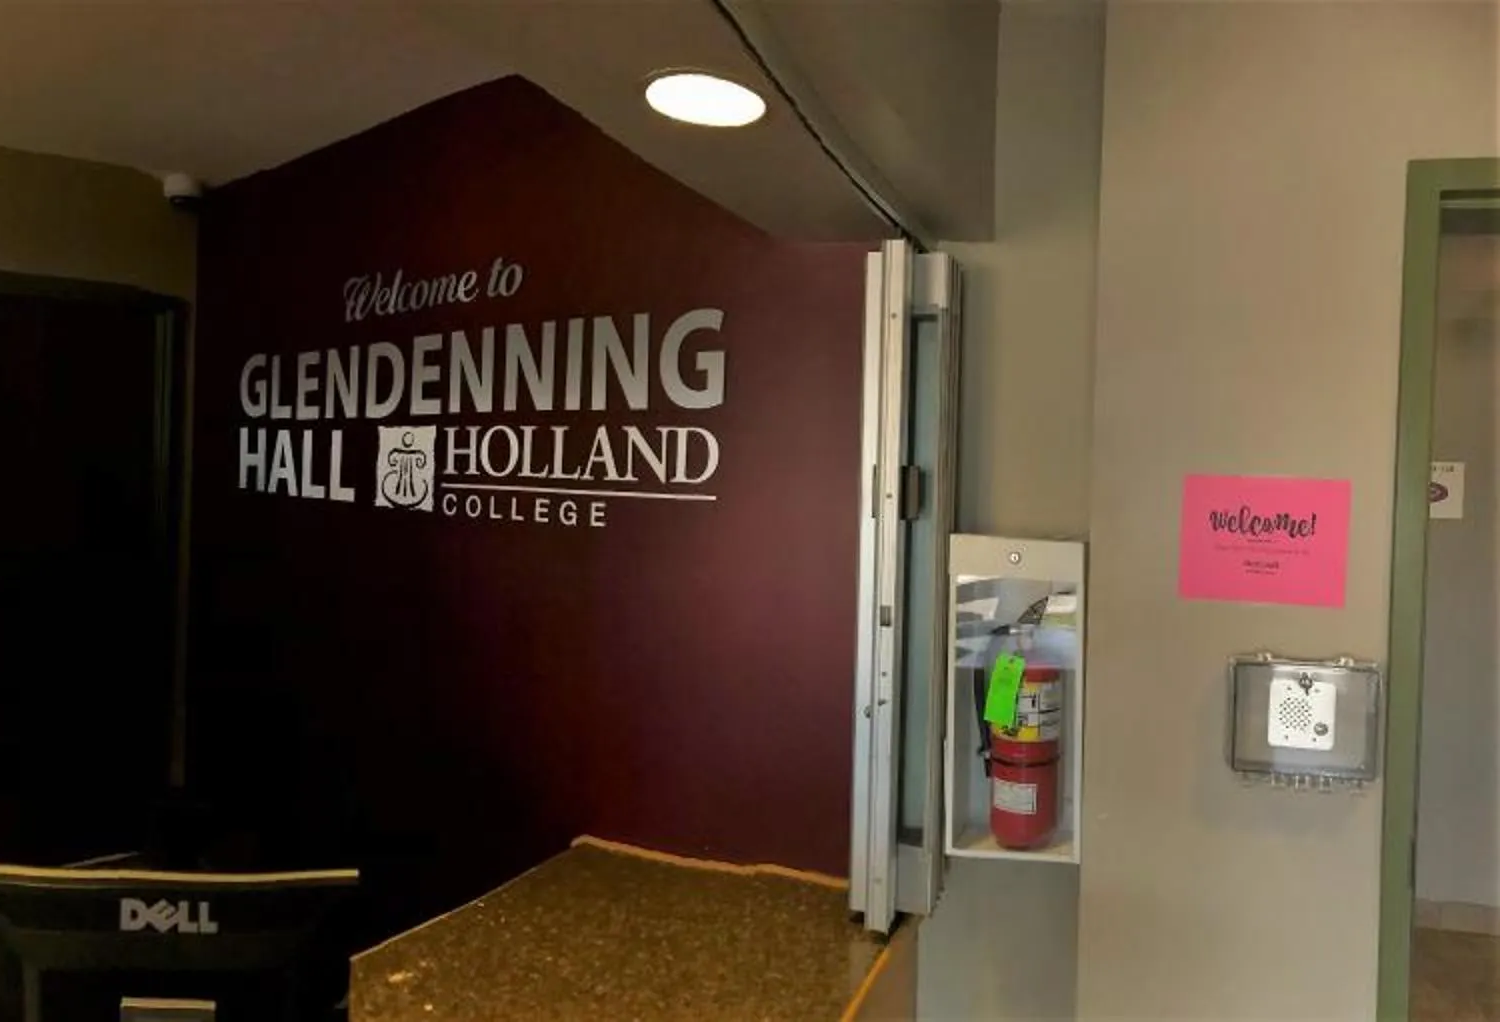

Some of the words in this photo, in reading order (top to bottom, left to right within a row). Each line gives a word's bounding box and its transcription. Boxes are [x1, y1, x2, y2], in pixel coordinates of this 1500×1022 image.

[343, 268, 479, 322] Welcome
[486, 257, 524, 298] to
[238, 308, 726, 420] GLENDENNING
[238, 426, 356, 502] HALL
[442, 424, 721, 484] HOLLAND
[442, 492, 608, 527] COLLEGE
[1209, 505, 1317, 538] welcome!
[119, 898, 219, 934] DELL
